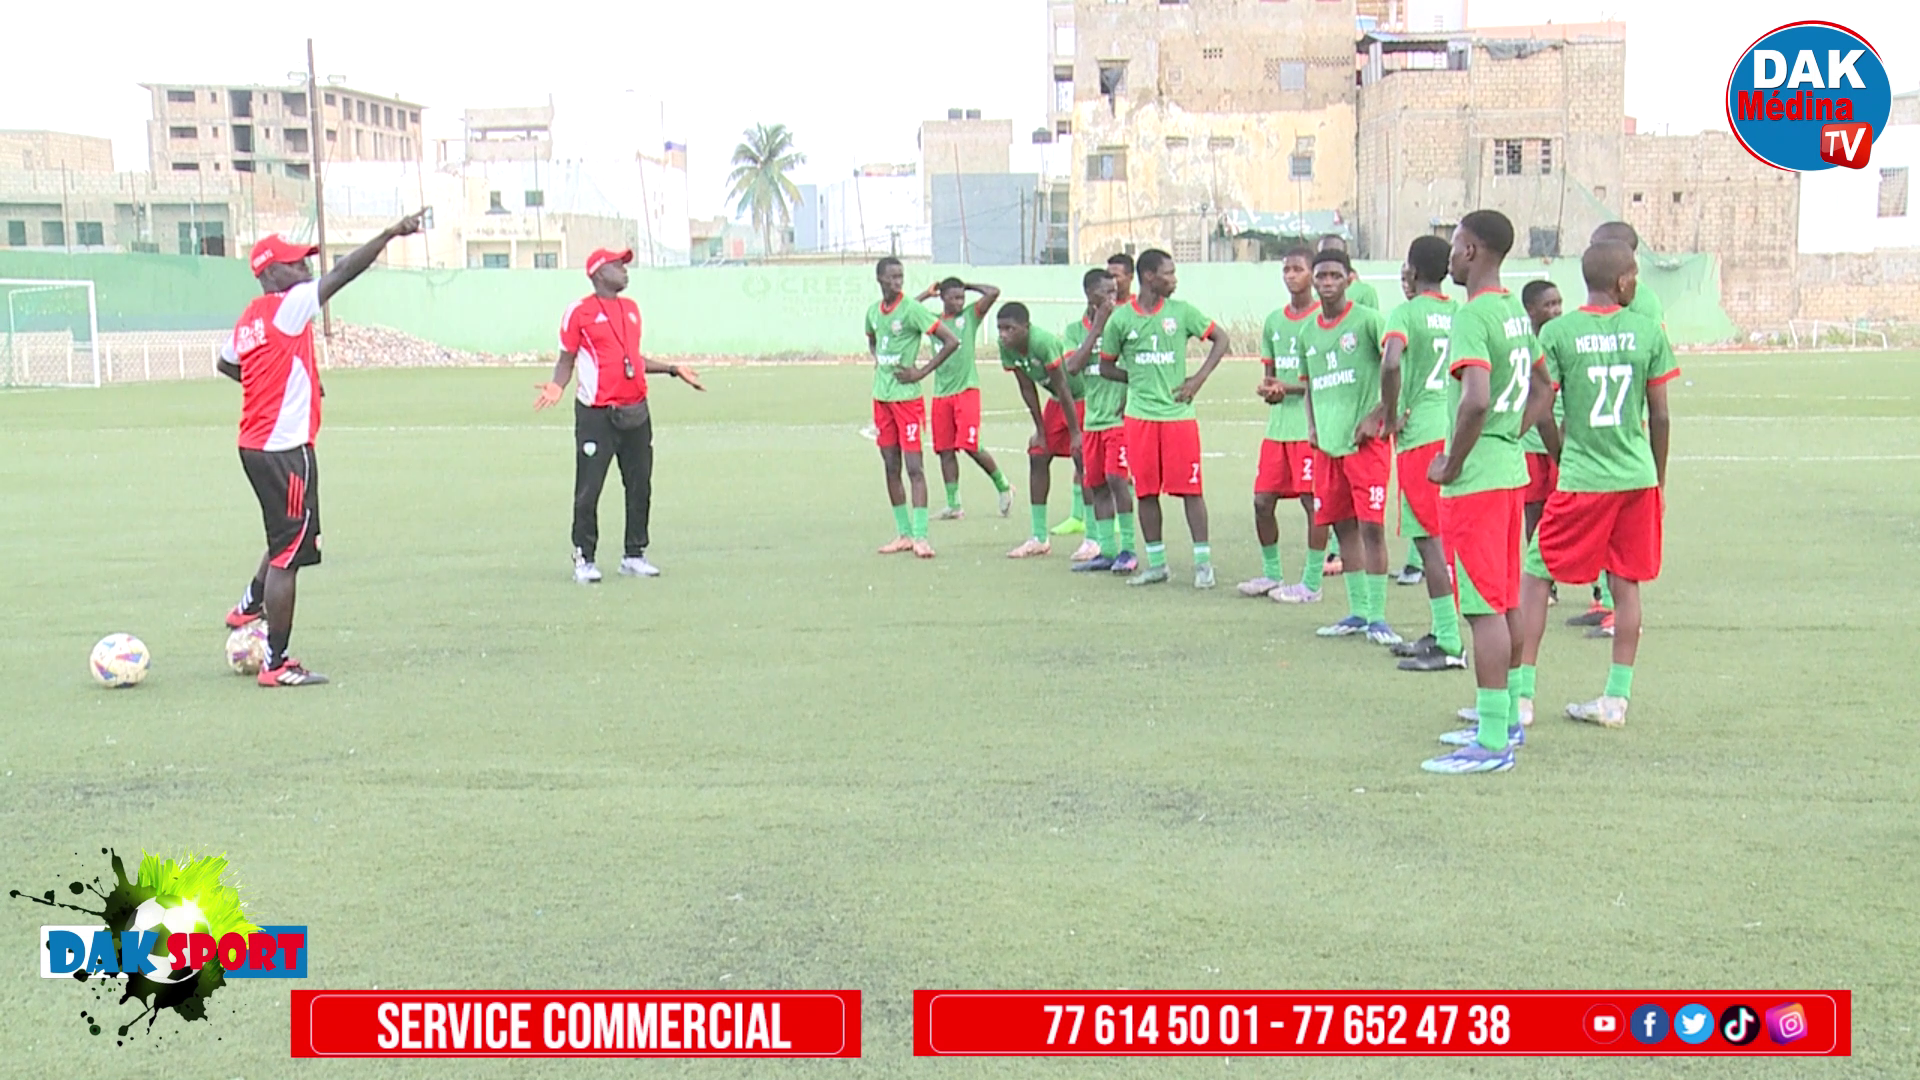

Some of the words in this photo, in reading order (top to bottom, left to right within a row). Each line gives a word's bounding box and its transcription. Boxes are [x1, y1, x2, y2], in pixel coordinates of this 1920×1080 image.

[1289, 336, 1297, 355] 2
[1618, 332, 1636, 351] 72
[1326, 351, 1338, 371] 18
[1312, 369, 1357, 391] ACADEMIE
[1494, 347, 1532, 413] 29
[1587, 364, 1633, 428] 27
[1304, 459, 1312, 472] 2
[1369, 486, 1385, 502] 18
